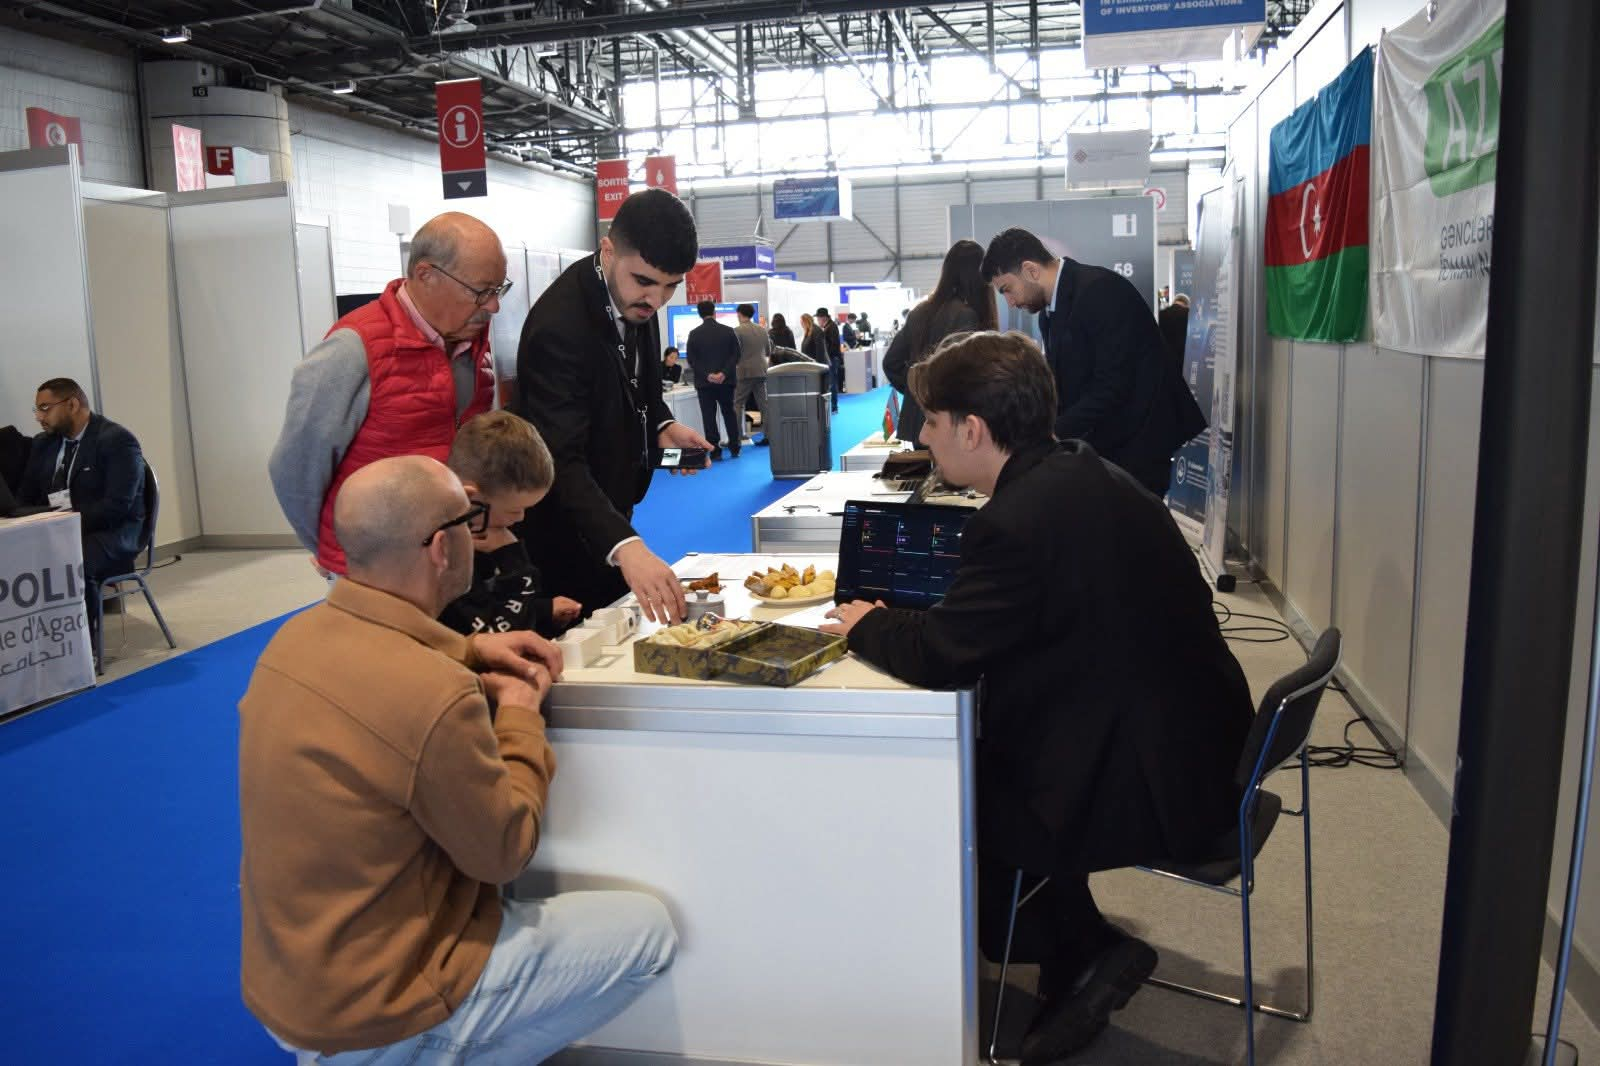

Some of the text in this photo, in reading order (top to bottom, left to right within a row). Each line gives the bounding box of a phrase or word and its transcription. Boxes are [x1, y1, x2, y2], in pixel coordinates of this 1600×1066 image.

[1100, 8, 1113, 16] OF
[1175, 0, 1243, 9] ASSOCIATIONS
[216, 149, 229, 168] F
[598, 177, 628, 188] SORTIE
[604, 192, 623, 201] EXIT
